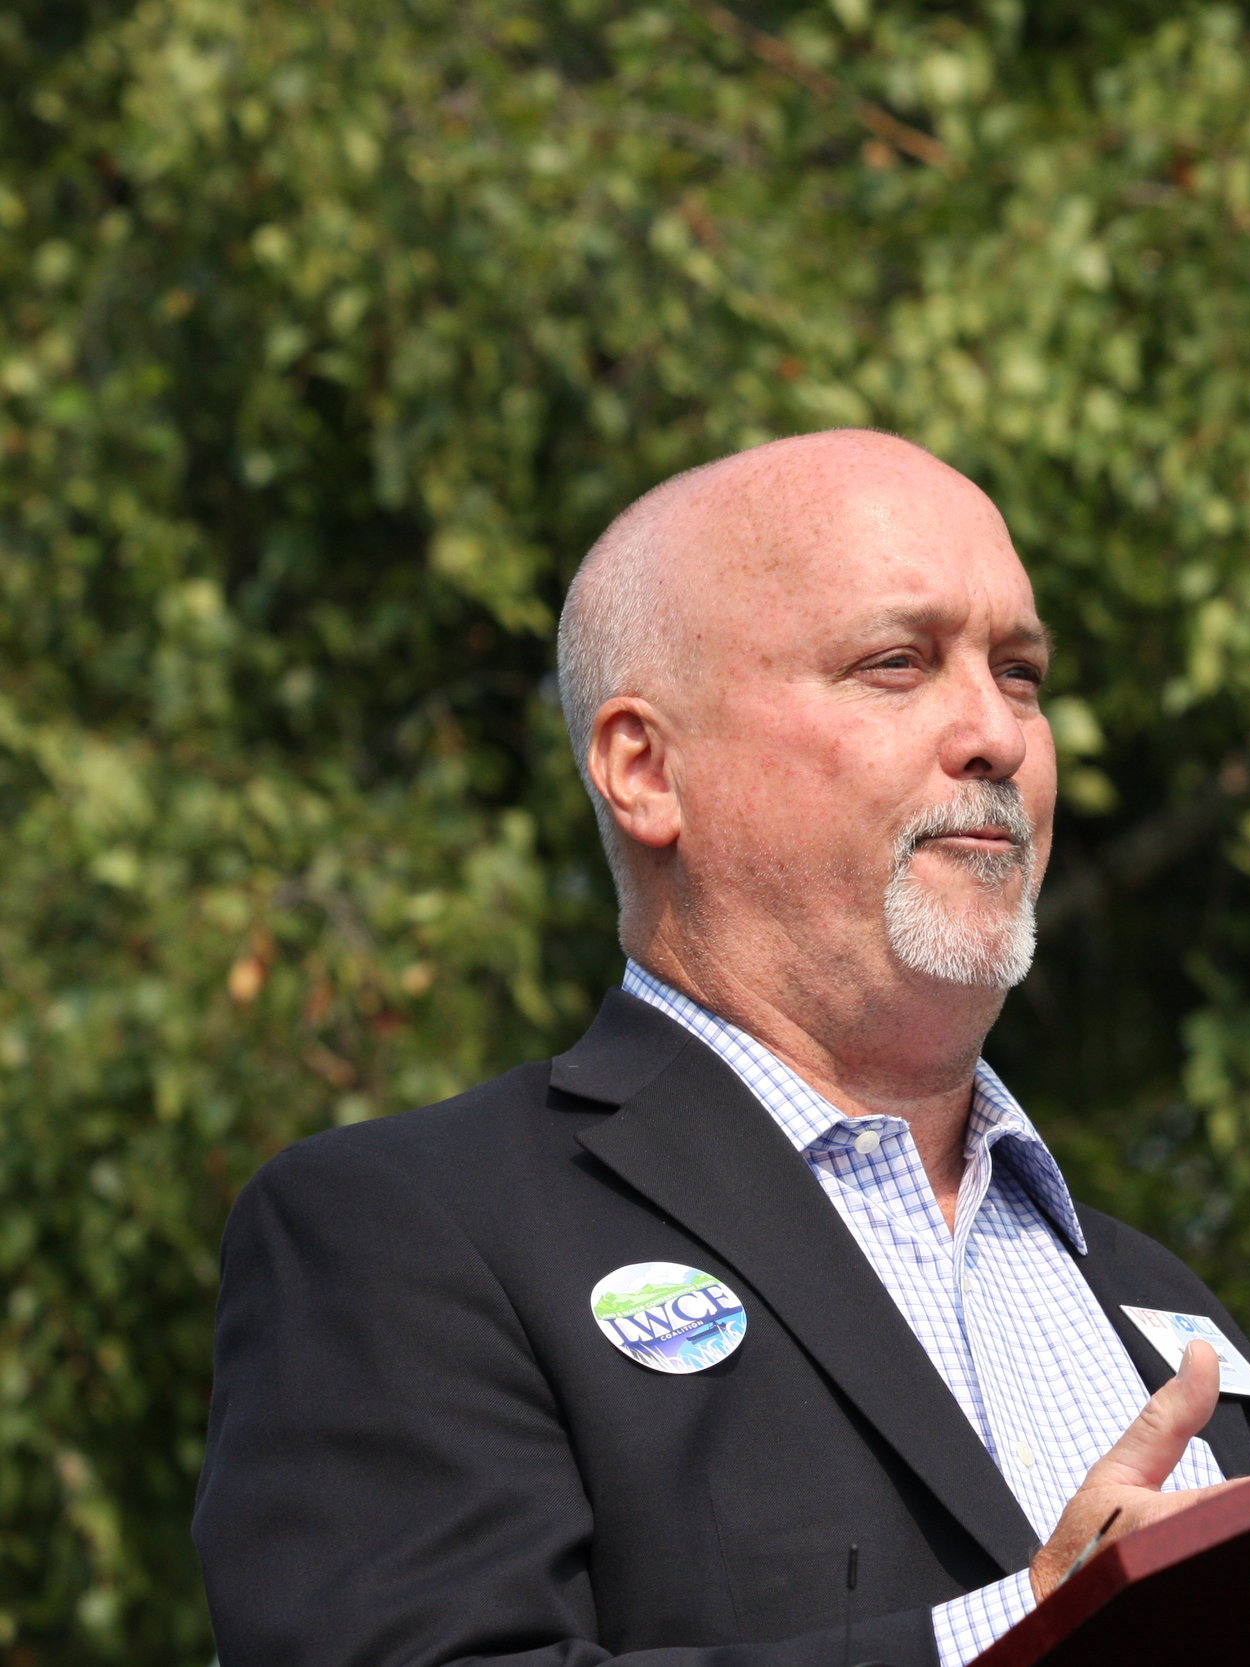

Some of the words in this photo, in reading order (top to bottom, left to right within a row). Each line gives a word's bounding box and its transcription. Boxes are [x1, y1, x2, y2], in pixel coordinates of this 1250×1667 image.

[603, 1284, 729, 1347] LWCF
[622, 1305, 645, 1316] WATER
[1127, 1307, 1167, 1328] VET
[1160, 1312, 1221, 1336] VOICE
[660, 1320, 704, 1341] COALITION
